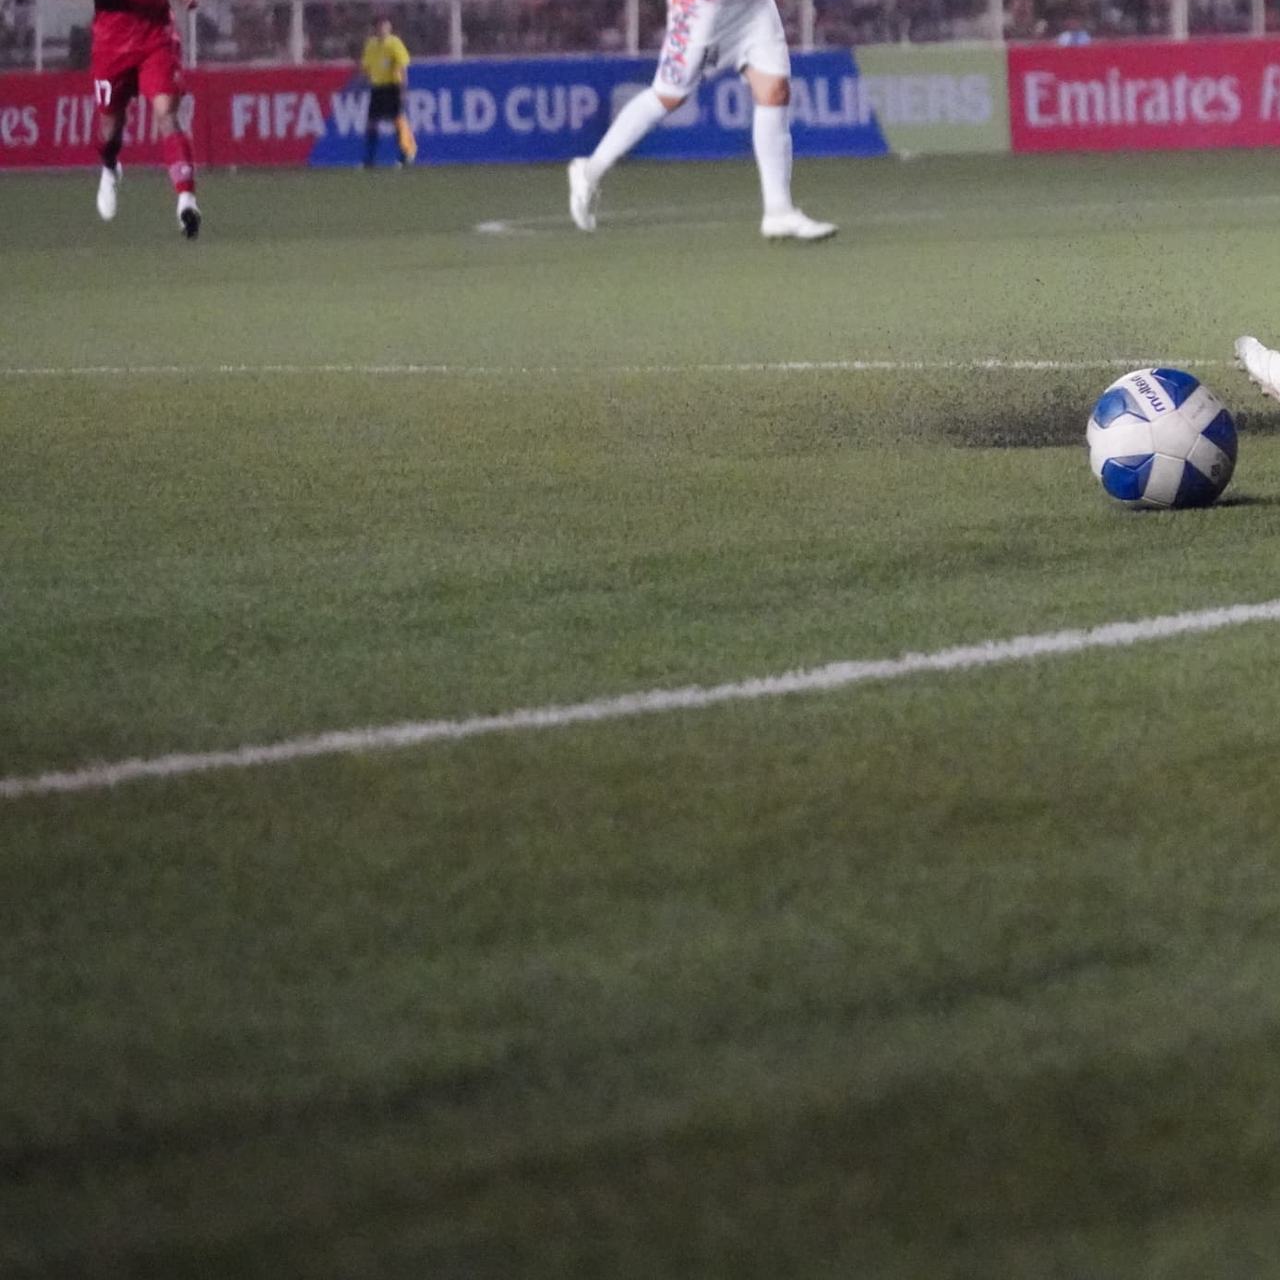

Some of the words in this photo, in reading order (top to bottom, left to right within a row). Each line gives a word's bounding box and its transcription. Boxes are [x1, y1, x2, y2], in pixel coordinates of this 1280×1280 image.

[95, 79, 112, 107] 17
[231, 90, 326, 139] FIFA
[330, 87, 497, 137] WRLD
[505, 84, 599, 132] CUP
[717, 73, 992, 128] QALIFIERS
[1024, 67, 1242, 128] Emirates
[1130, 375, 1167, 413] molten
